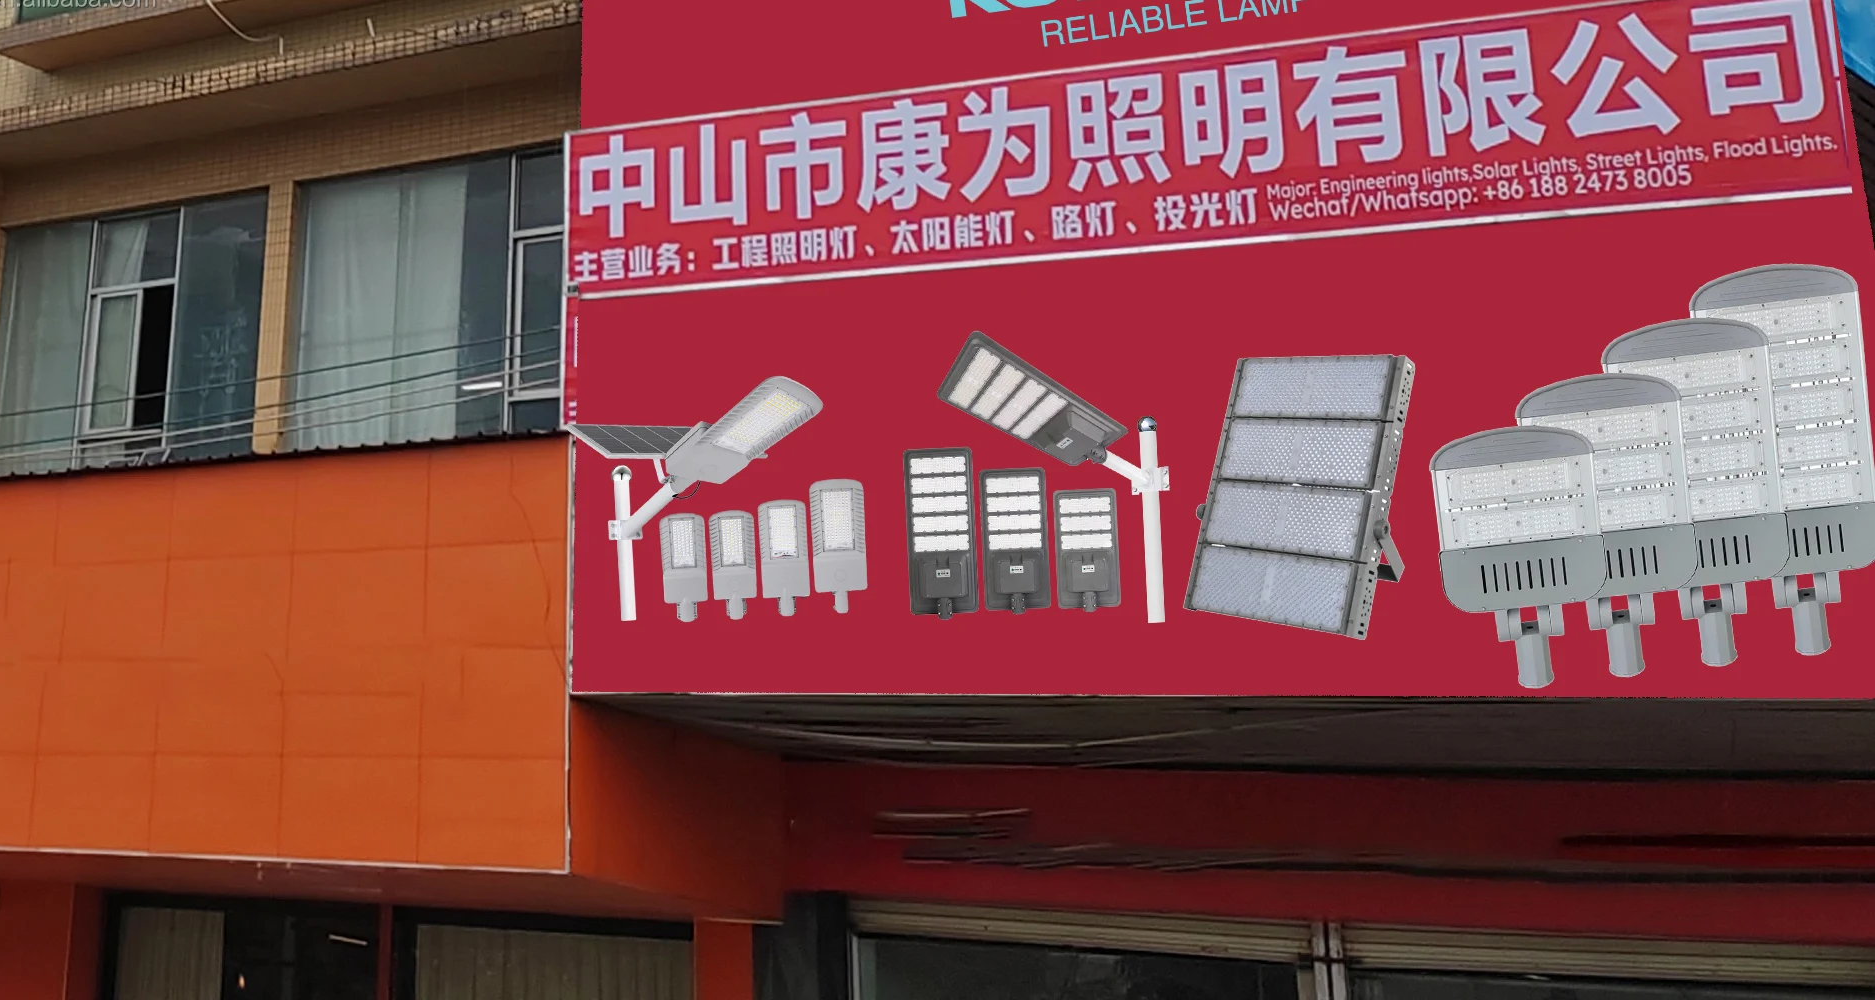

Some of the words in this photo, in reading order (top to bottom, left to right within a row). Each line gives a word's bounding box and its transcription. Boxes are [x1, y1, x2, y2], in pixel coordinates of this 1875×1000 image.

[1319, 171, 1420, 198] Engineering
[1585, 149, 1642, 171] Street
[1713, 136, 1768, 159] Flood
[1772, 133, 1838, 157] Lights.
[1483, 180, 1525, 201] +86
[1529, 175, 1568, 198] 188
[1574, 170, 1628, 194] 2473
[1633, 164, 1693, 188] 8005
